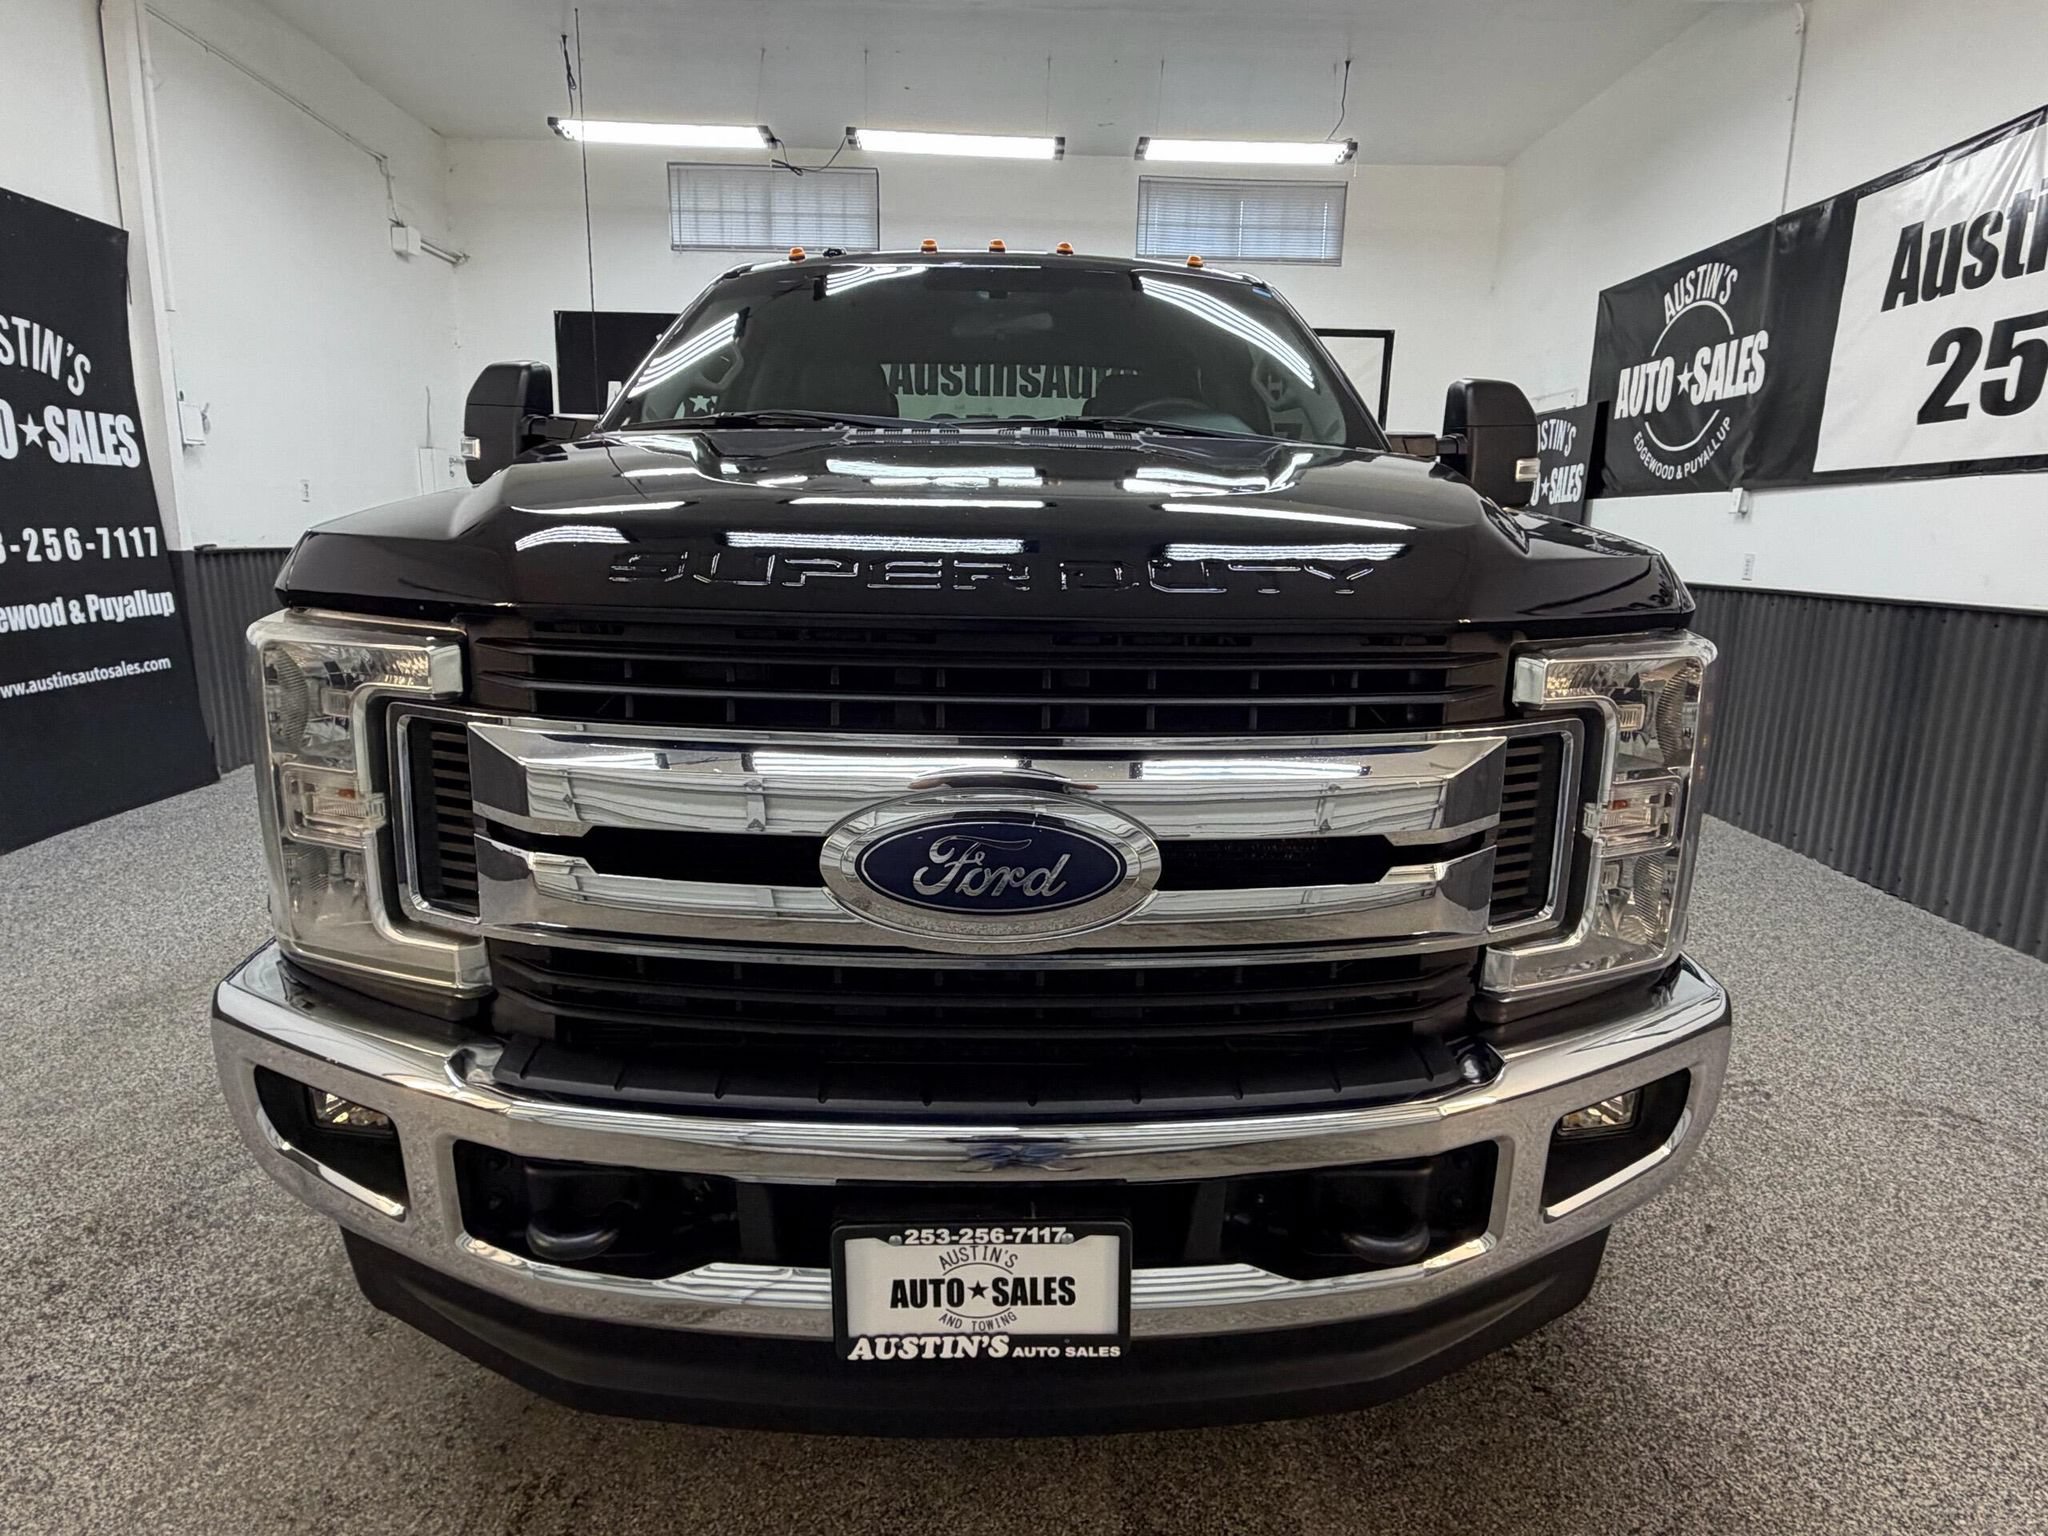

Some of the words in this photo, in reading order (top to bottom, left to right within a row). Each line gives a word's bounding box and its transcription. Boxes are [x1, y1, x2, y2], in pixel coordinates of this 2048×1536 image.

[1664, 262, 1738, 325] AUSTIN'S
[1613, 356, 1675, 419] AUTO
[1690, 330, 1769, 406] SALES
[43, 405, 141, 469] SALES
[1538, 418, 1577, 457] STIN'S
[1633, 431, 1675, 480] EDGEWOOD
[1675, 464, 1683, 480] &
[1684, 416, 1731, 477] PUYALLUP
[1548, 463, 1585, 505] SALES
[608, 550, 1031, 592] SUPER
[1059, 559, 1375, 595] DUTY
[68, 599, 87, 625] &
[85, 589, 176, 624] Puyallup
[912, 835, 1067, 897] Ford
[904, 1227, 1067, 1245] 253-256-7117
[938, 1245, 1018, 1271] AUSTIN'S
[890, 1278, 964, 1308] AUTO
[991, 1276, 1076, 1307] SALES
[938, 1312, 963, 1330] AND
[971, 1311, 1018, 1332] TOWING
[847, 1335, 1010, 1361] AUSTIN'S
[1012, 1346, 1060, 1358] AUTO
[1064, 1346, 1121, 1358] SALES
